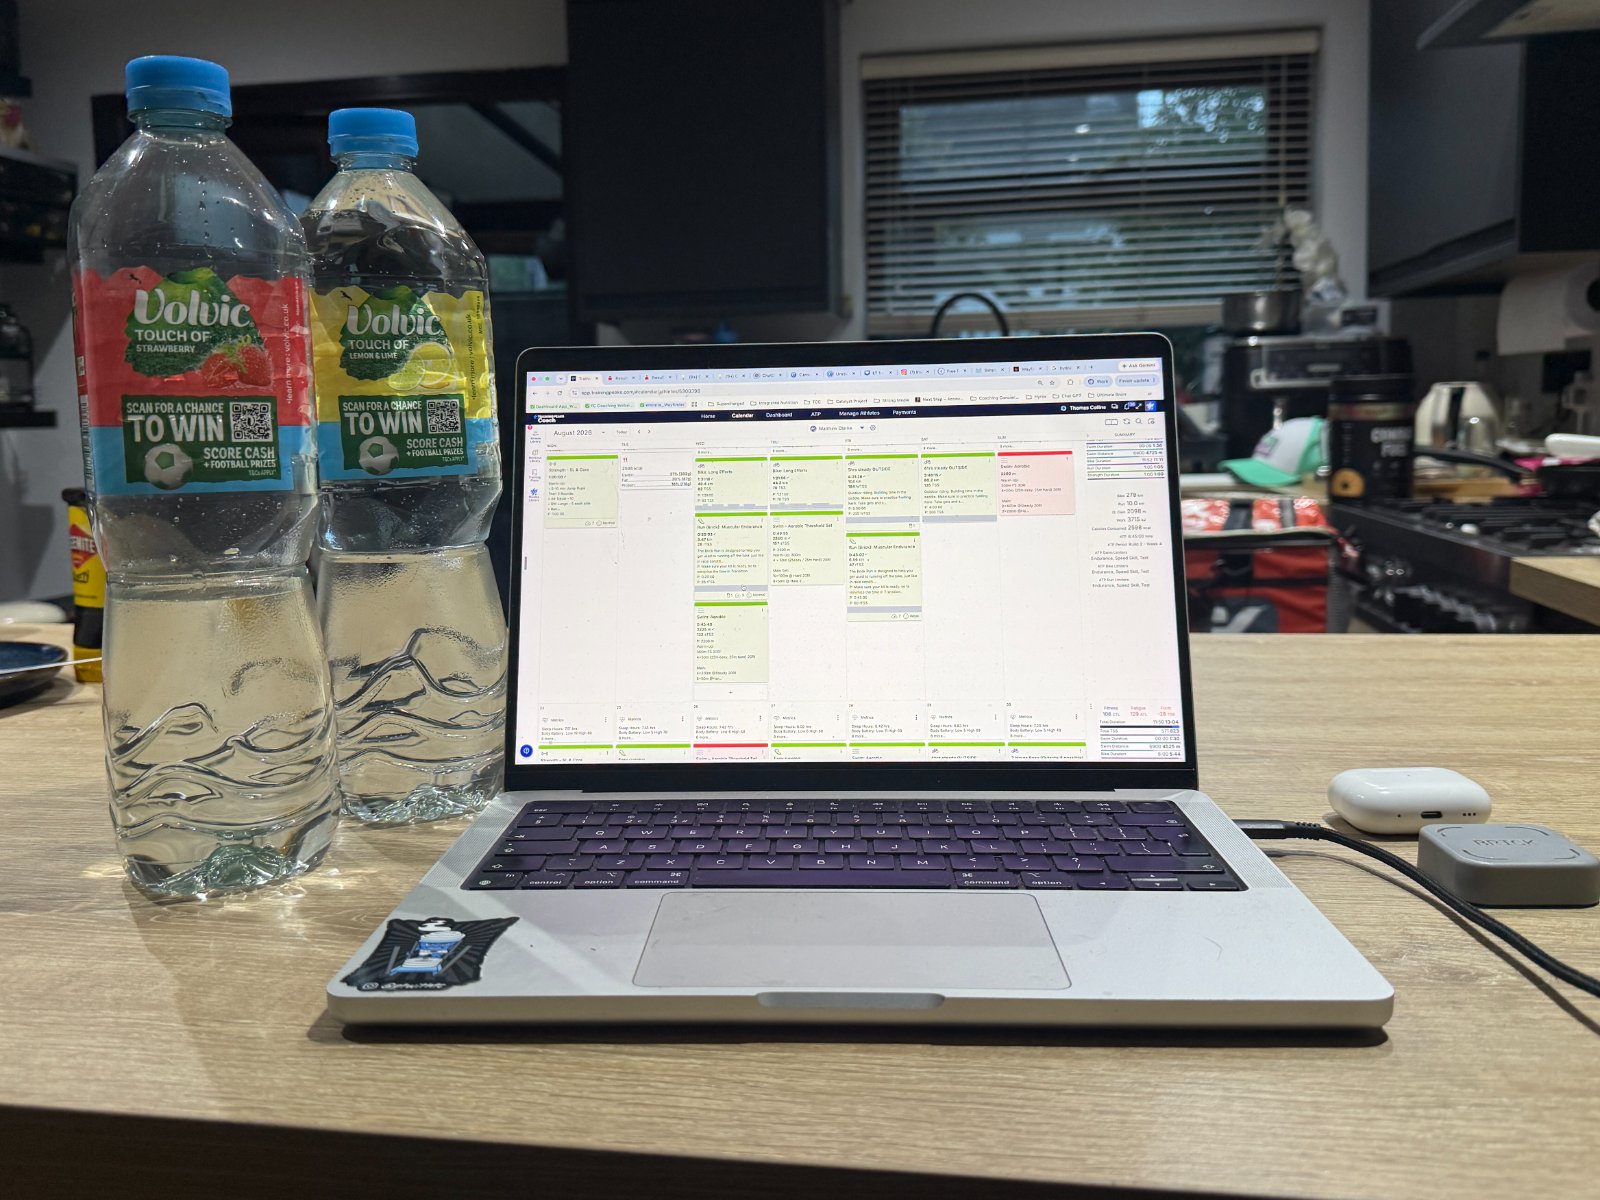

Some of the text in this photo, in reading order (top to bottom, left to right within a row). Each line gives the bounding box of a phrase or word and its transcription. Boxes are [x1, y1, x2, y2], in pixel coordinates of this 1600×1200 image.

[133, 288, 250, 328] Volvic
[347, 304, 441, 335] Volvic
[134, 330, 211, 342] TOUCH OF
[136, 345, 196, 353] STRAWBERRY
[348, 340, 409, 350] TOUCH OF
[127, 402, 224, 414] SCAN FOR A CHANCE
[343, 400, 422, 412] SCAN FOR A CHANCE
[128, 414, 224, 442] TO WIN
[344, 411, 422, 435] TO WIN
[407, 436, 463, 448] SCORE CASH
[204, 446, 275, 460] SCORE CASH
[211, 460, 250, 468] FOOTBALL
[250, 460, 276, 468] PRIZES
